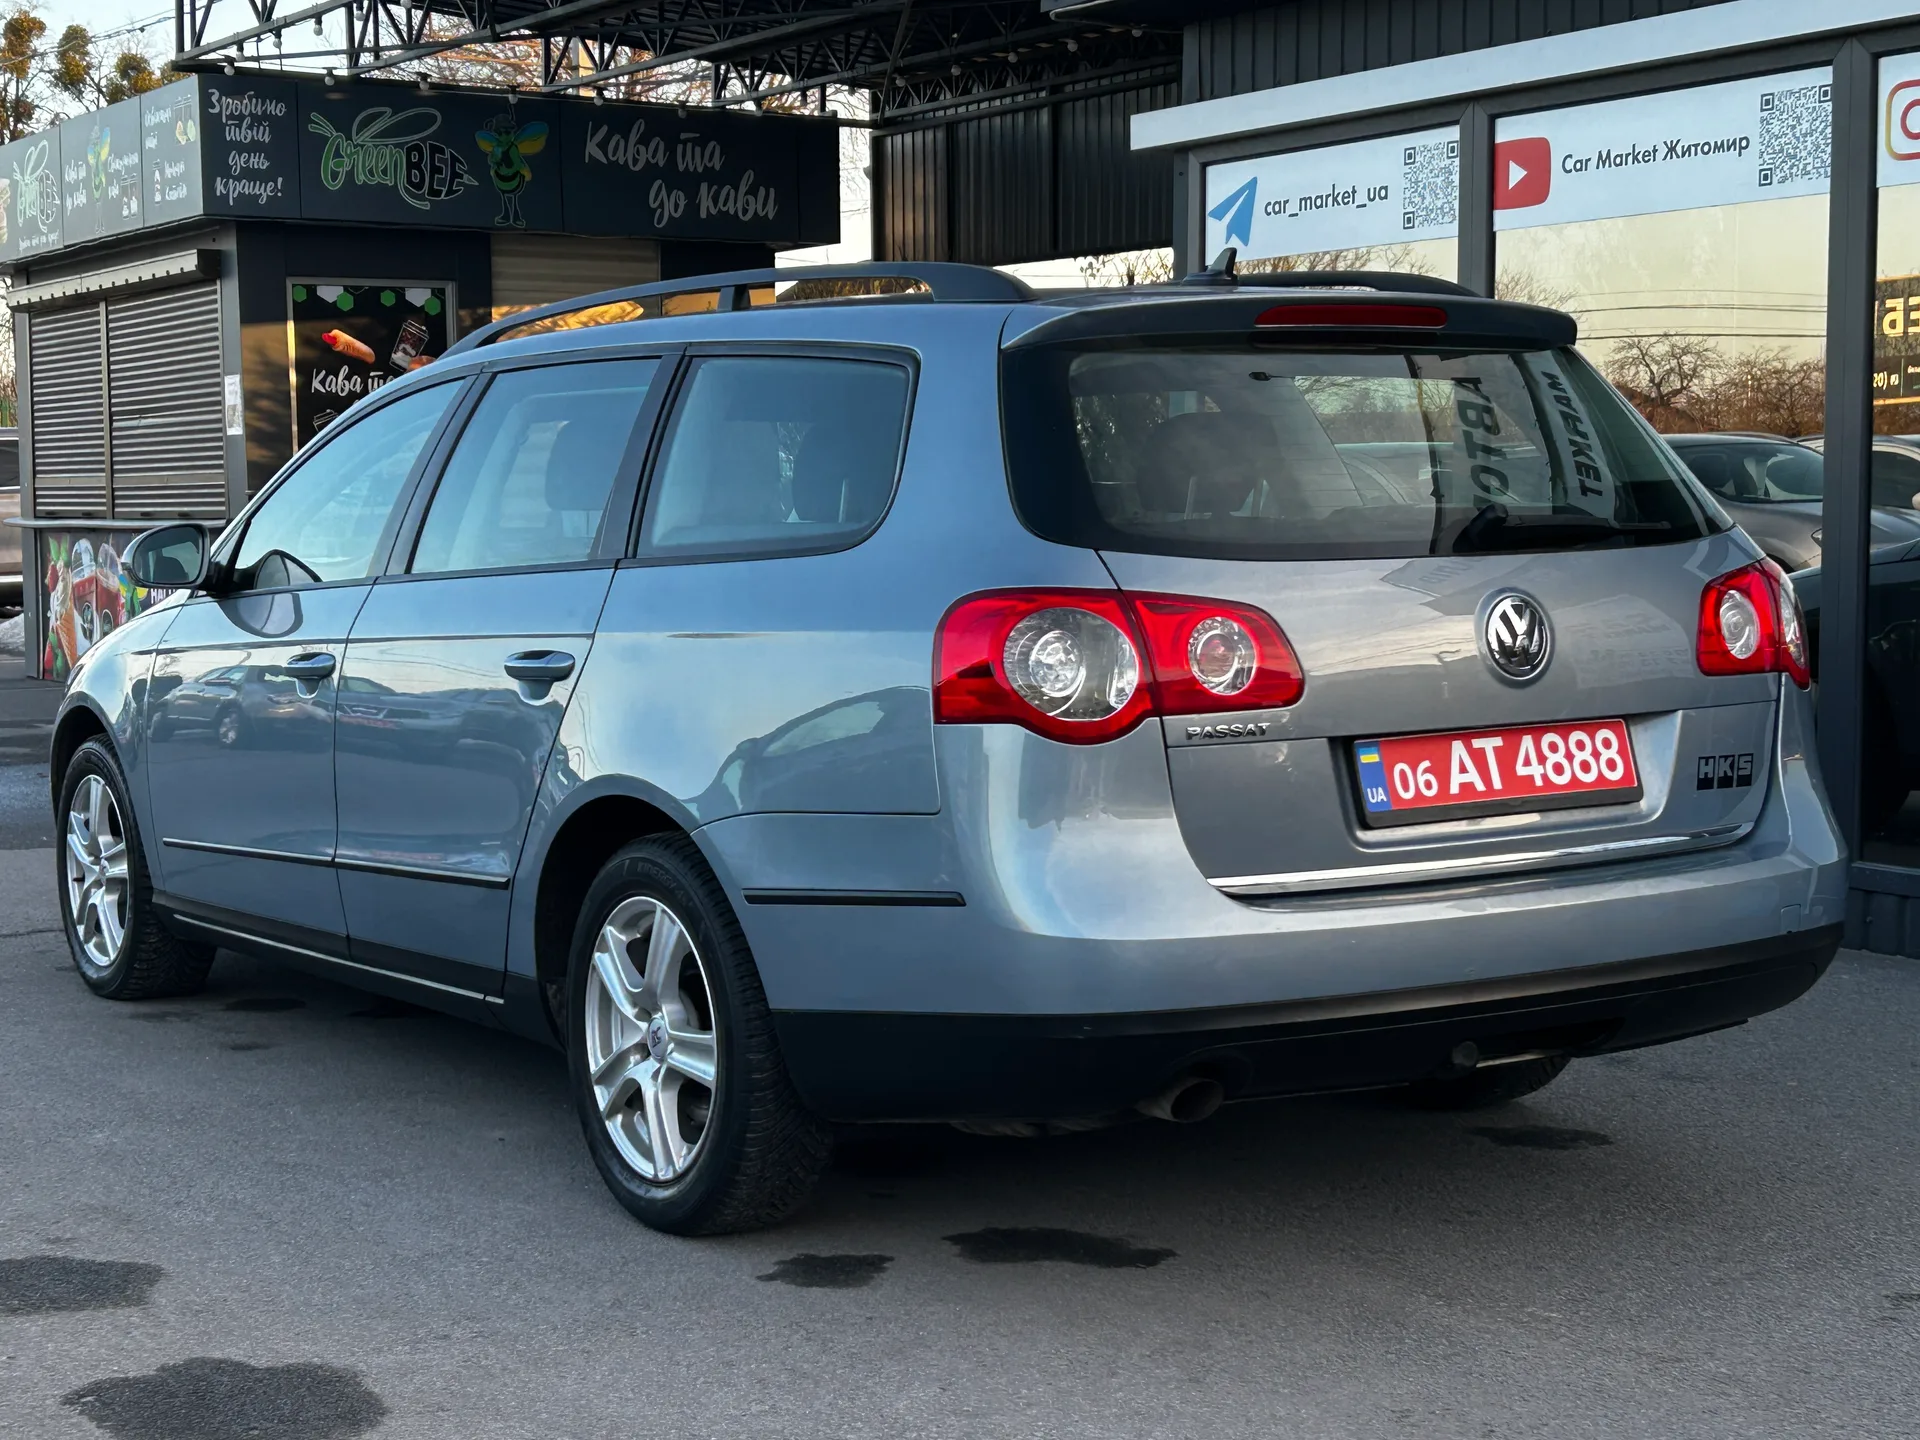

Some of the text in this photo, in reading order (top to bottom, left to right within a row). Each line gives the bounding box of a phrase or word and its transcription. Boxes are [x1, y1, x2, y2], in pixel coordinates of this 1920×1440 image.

[207, 88, 287, 123] Зробимо
[225, 119, 272, 144] твій
[584, 118, 725, 172] Кава та
[228, 150, 271, 176] день
[1561, 135, 1751, 174] Car Market Житомир
[214, 176, 284, 206] краще!
[649, 169, 778, 228] до кави
[1264, 183, 1389, 217] car_market_ua
[311, 365, 364, 397] Кава
[1185, 721, 1271, 741] PASSAT
[1393, 728, 1625, 800] 06 AT 4888
[1697, 754, 1753, 790] HKS
[1367, 787, 1387, 804] UA
